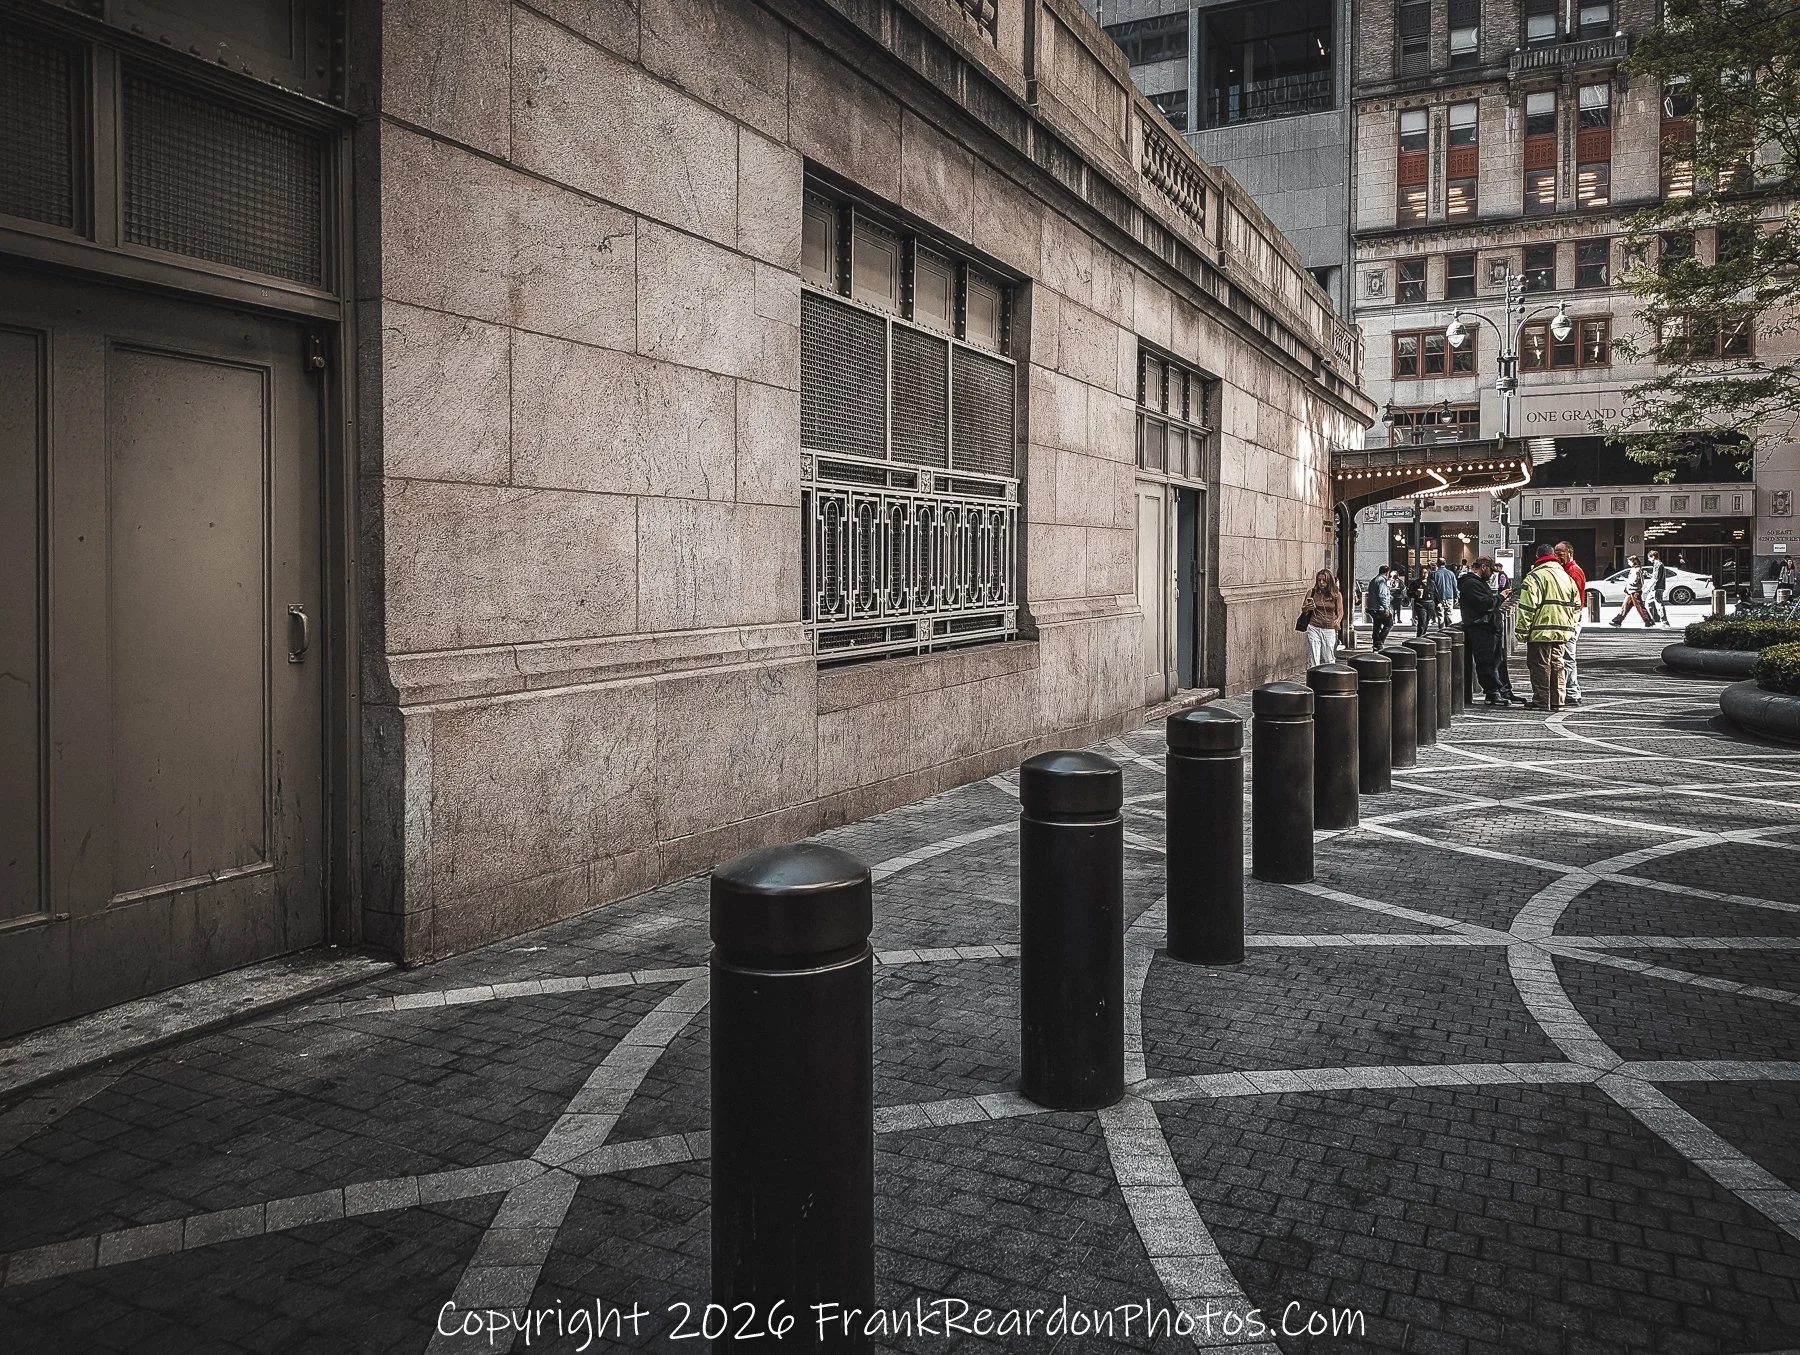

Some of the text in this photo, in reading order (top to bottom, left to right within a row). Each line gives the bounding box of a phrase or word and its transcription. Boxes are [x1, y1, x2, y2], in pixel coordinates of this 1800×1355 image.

[1526, 411, 1558, 423] ONE
[1561, 408, 1617, 421] GRAND
[1442, 504, 1474, 512] COFFEE
